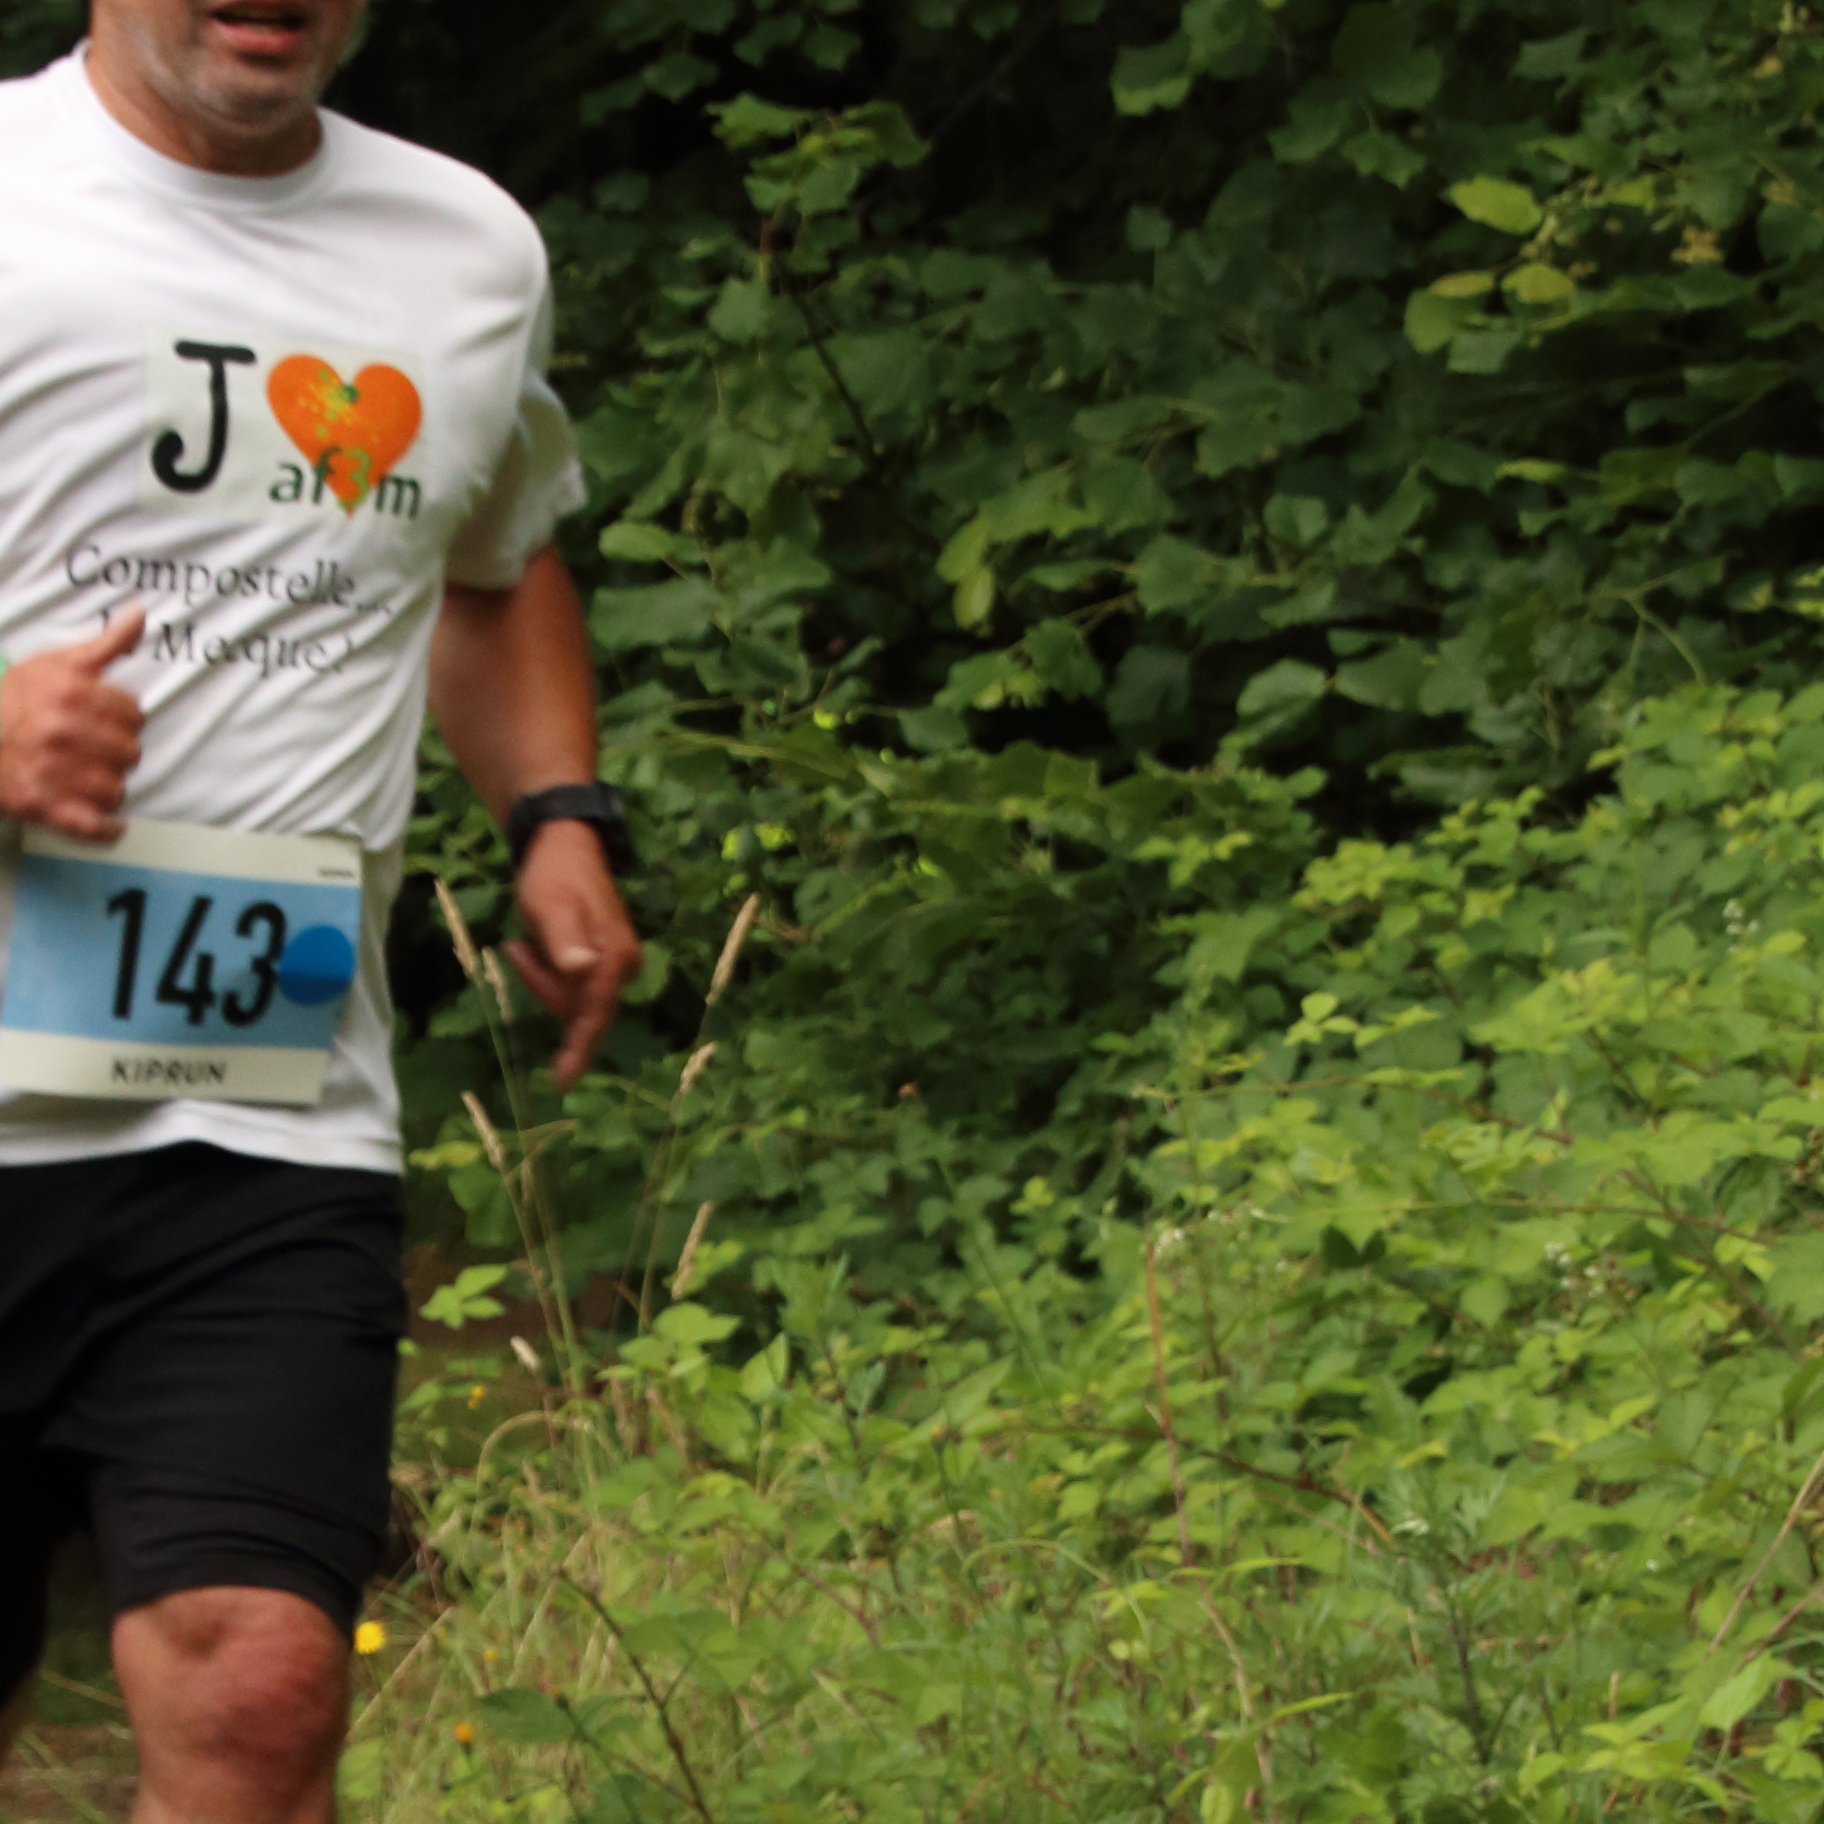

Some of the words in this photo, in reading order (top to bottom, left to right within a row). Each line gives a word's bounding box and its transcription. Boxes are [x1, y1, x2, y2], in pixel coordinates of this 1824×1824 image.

[152, 340, 257, 492] J
[107, 887, 287, 1027] 143
[113, 1059, 227, 1084] KIPRUN
